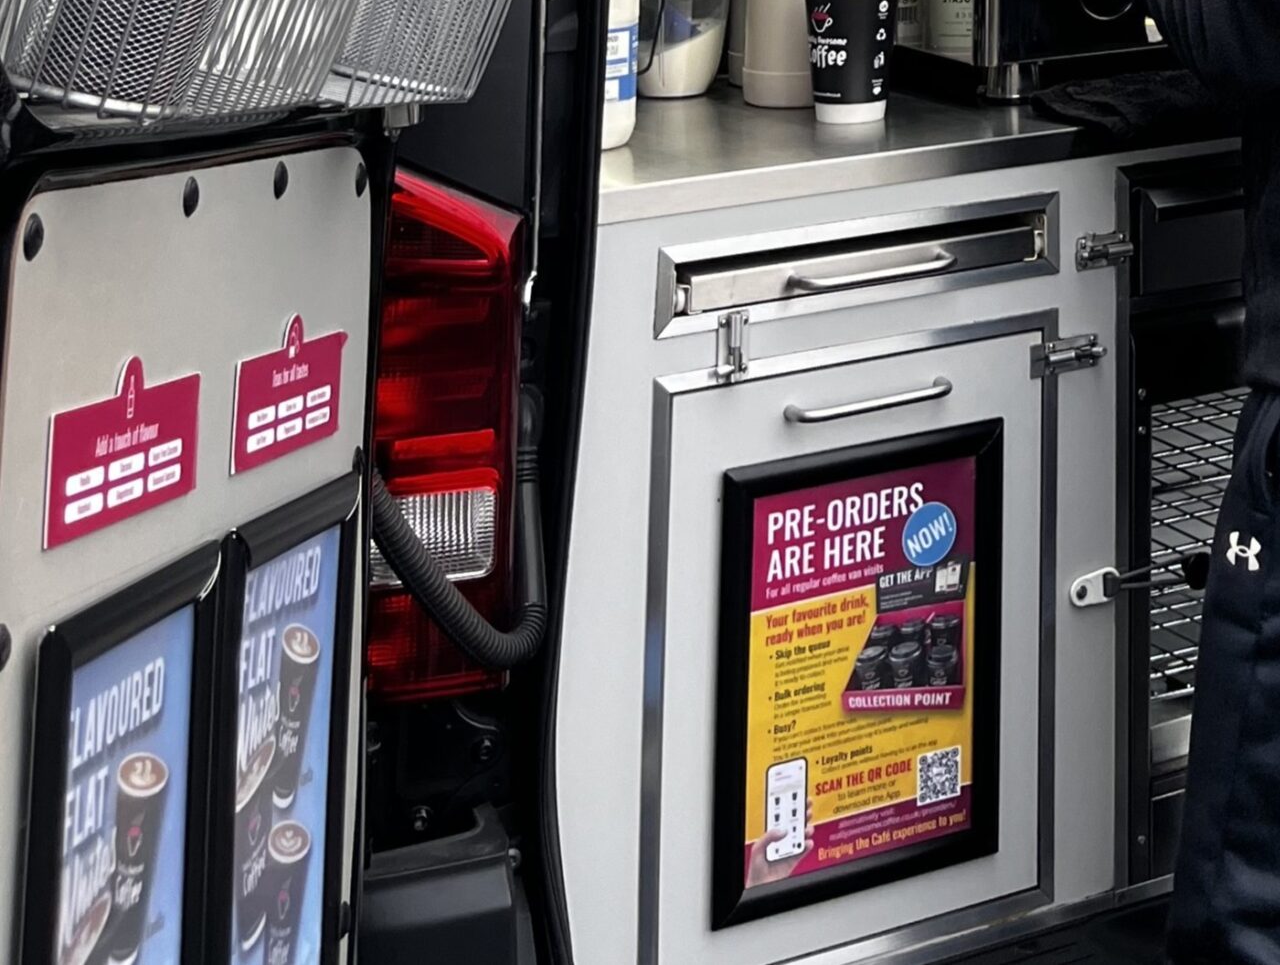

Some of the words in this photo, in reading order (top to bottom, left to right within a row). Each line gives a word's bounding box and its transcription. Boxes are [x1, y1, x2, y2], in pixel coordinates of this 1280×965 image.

[810, 45, 847, 68] offee
[95, 434, 110, 457] Add
[767, 482, 924, 546] PRE-ORDERS
[906, 512, 953, 558] NOW!
[766, 541, 816, 584] ARE
[824, 526, 886, 571] HERE
[766, 586, 779, 600] For
[780, 583, 791, 596] all
[792, 577, 820, 595] regular
[822, 572, 847, 588] coffee
[848, 570, 862, 583] van
[863, 563, 884, 579] visits
[879, 574, 895, 588] GET
[896, 571, 913, 585] THE
[765, 613, 788, 630] Your
[792, 600, 838, 622] favourite
[839, 594, 870, 613] drink,
[765, 629, 794, 649] ready
[797, 624, 823, 640] when
[825, 620, 844, 636] you
[846, 612, 866, 628] are!
[774, 649, 792, 662] Skip
[794, 644, 807, 656] the
[808, 639, 831, 654] queue
[774, 690, 792, 702] Bulk
[794, 683, 826, 699] ordering
[848, 690, 912, 708] COLLECTION
[914, 691, 952, 707] POINT
[70, 656, 165, 769] LAVOURED
[773, 720, 797, 735] Busy?
[821, 751, 848, 767] Loyalty
[850, 745, 873, 761] points
[815, 776, 842, 796] SCAN
[846, 772, 865, 790] THE
[867, 768, 882, 786] QR
[885, 758, 913, 777] CODE
[818, 843, 854, 862] Bringing
[855, 838, 869, 850] the
[871, 828, 890, 846] Café
[892, 819, 936, 839] experience
[939, 815, 948, 826] to
[949, 809, 966, 826] you!
